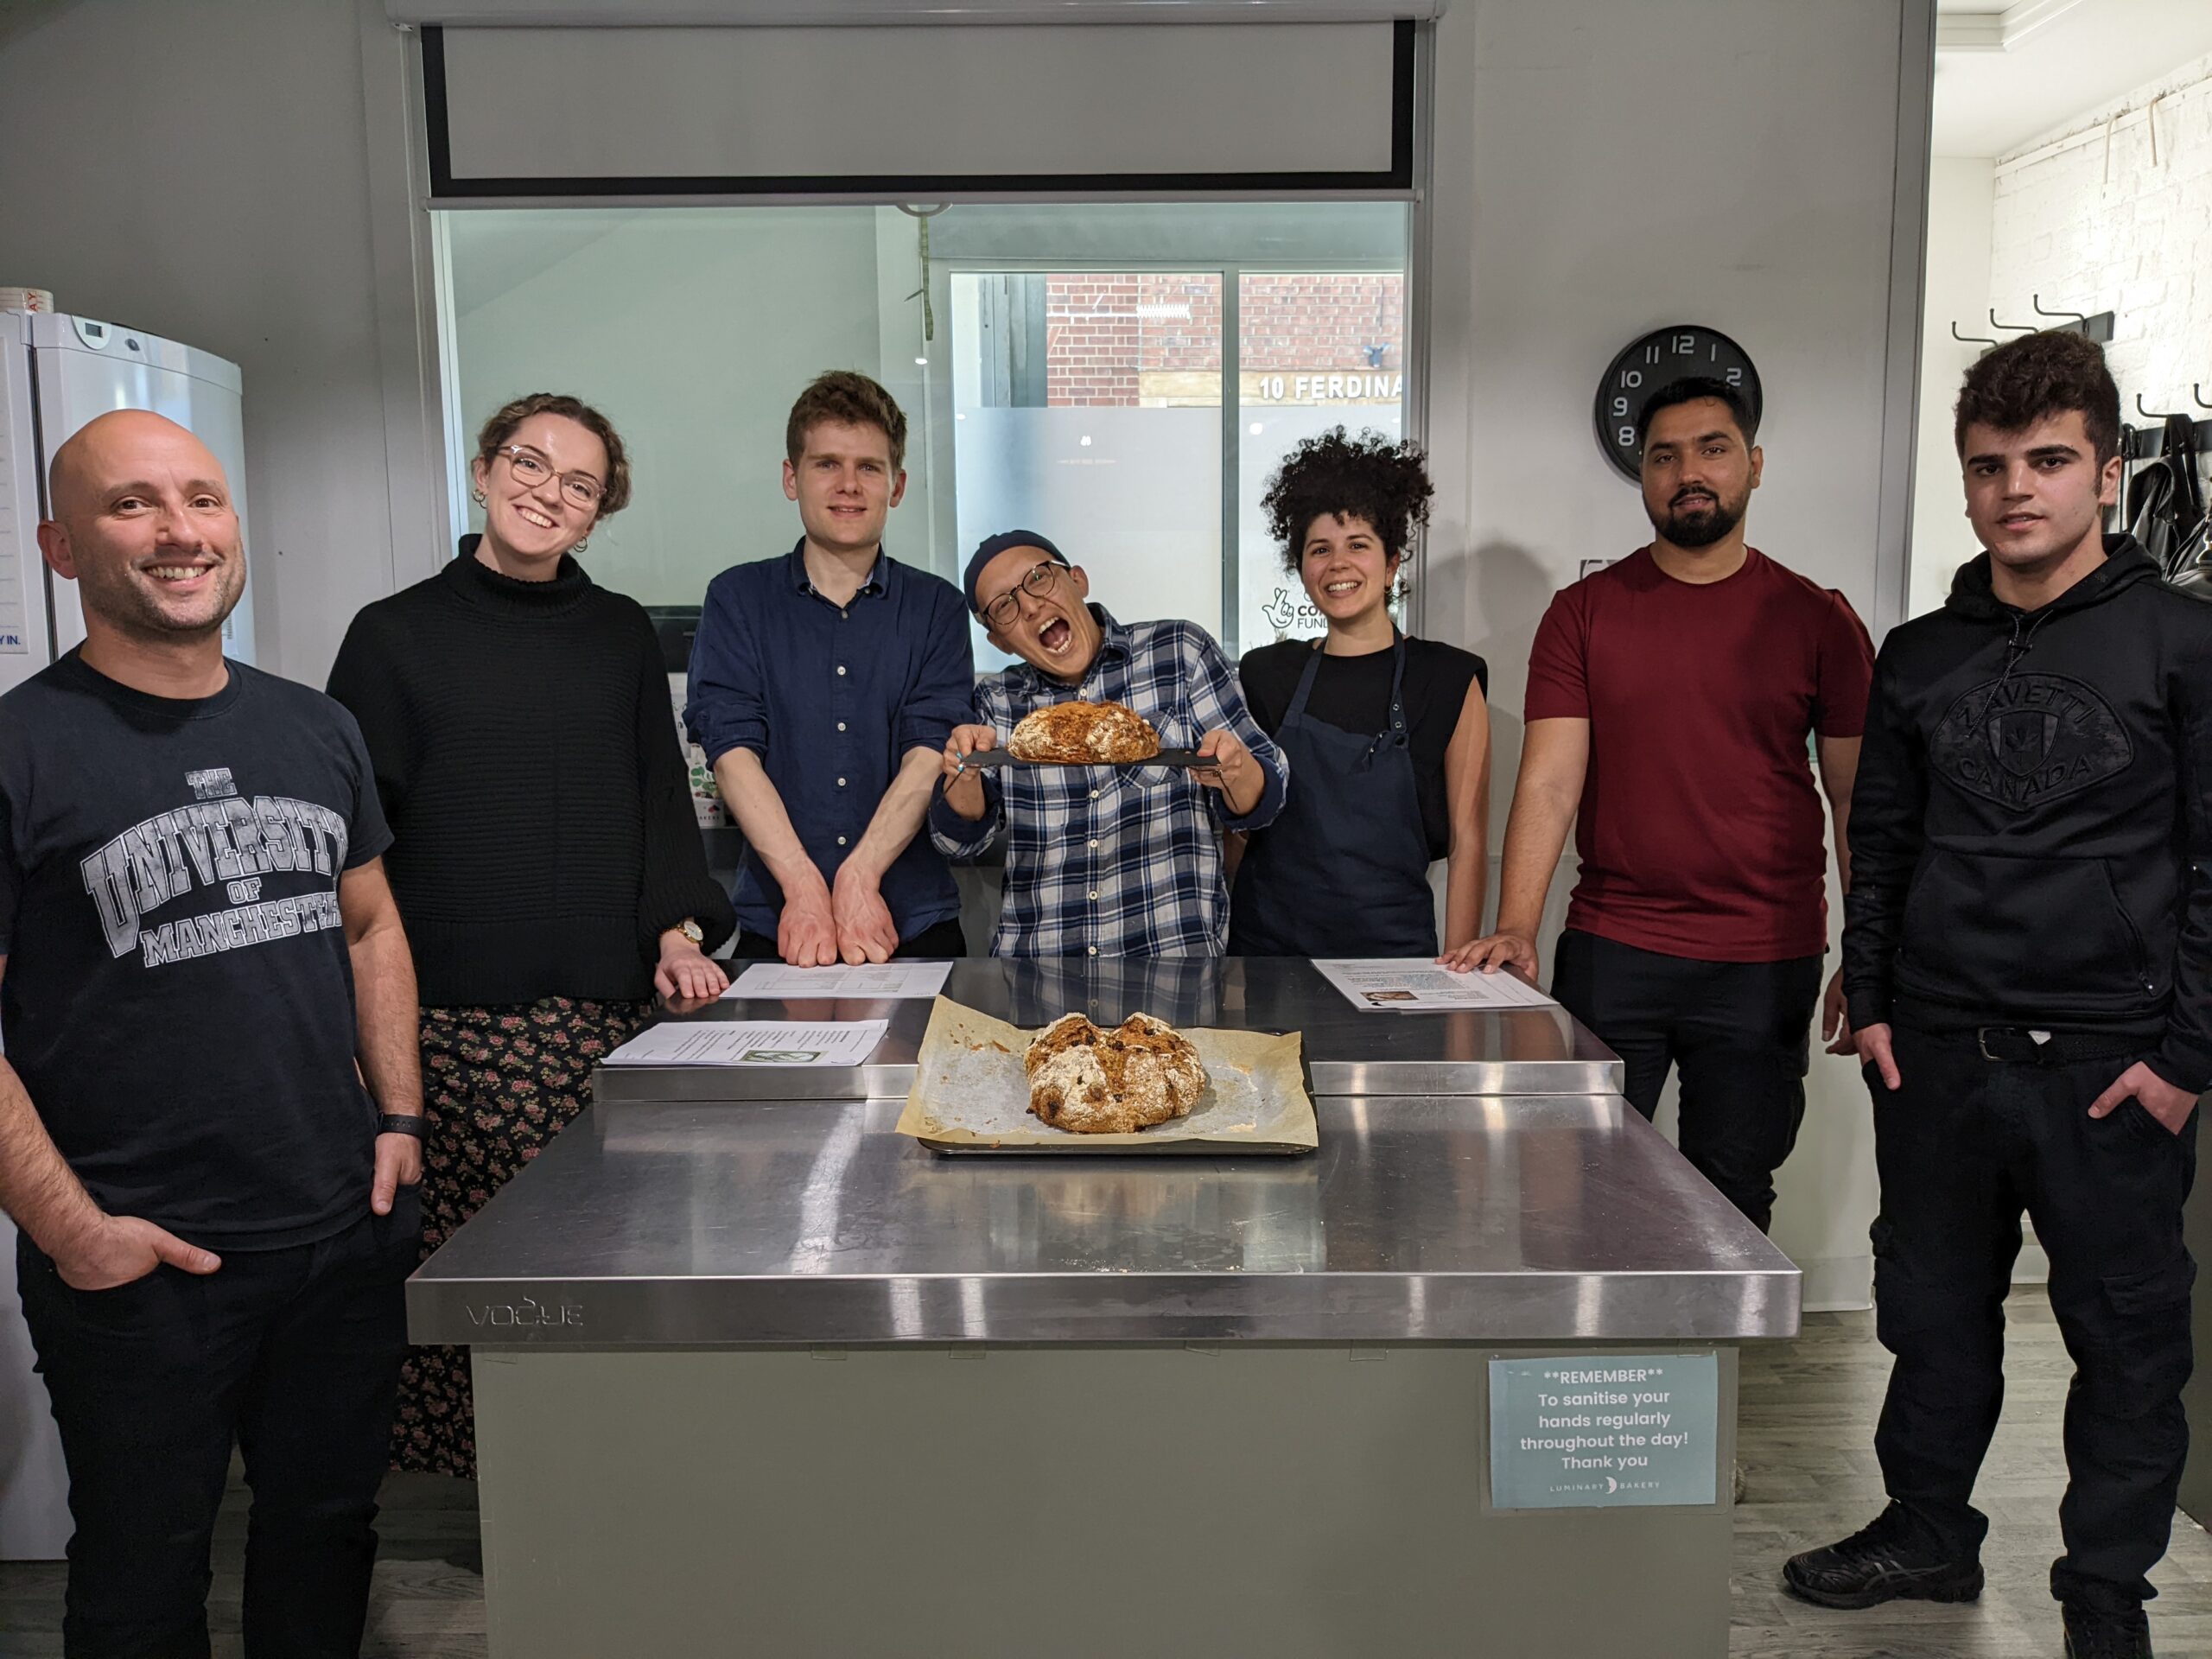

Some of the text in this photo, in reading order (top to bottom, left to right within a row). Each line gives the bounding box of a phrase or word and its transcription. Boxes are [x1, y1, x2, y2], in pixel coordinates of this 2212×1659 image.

[1672, 335, 1694, 353] 12
[1710, 344, 1716, 361] 1
[1646, 346, 1659, 364] 11
[1621, 371, 1642, 388] 10
[1726, 367, 1742, 386] 2
[1260, 376, 1284, 399] 10
[1613, 397, 1628, 416] 9
[1618, 426, 1635, 446] 8
[1298, 605, 1321, 616] CO
[7, 635, 21, 645] IN.
[1956, 683, 2096, 728] ZAVETTI
[184, 767, 238, 800] THE
[1958, 754, 2094, 802] CANADA
[80, 795, 348, 958] UNIVERSITY
[226, 877, 262, 904] OF
[140, 892, 343, 968] MANCHESTER
[466, 1296, 583, 1325] VOGUE
[1538, 1391, 1670, 1408] To sanitise your
[1539, 1412, 1671, 1429] hands regularly
[1521, 1432, 1688, 1452] throughout the day!
[1561, 1455, 1648, 1471] Thank you
[1550, 1484, 1604, 1492] LUMINARY
